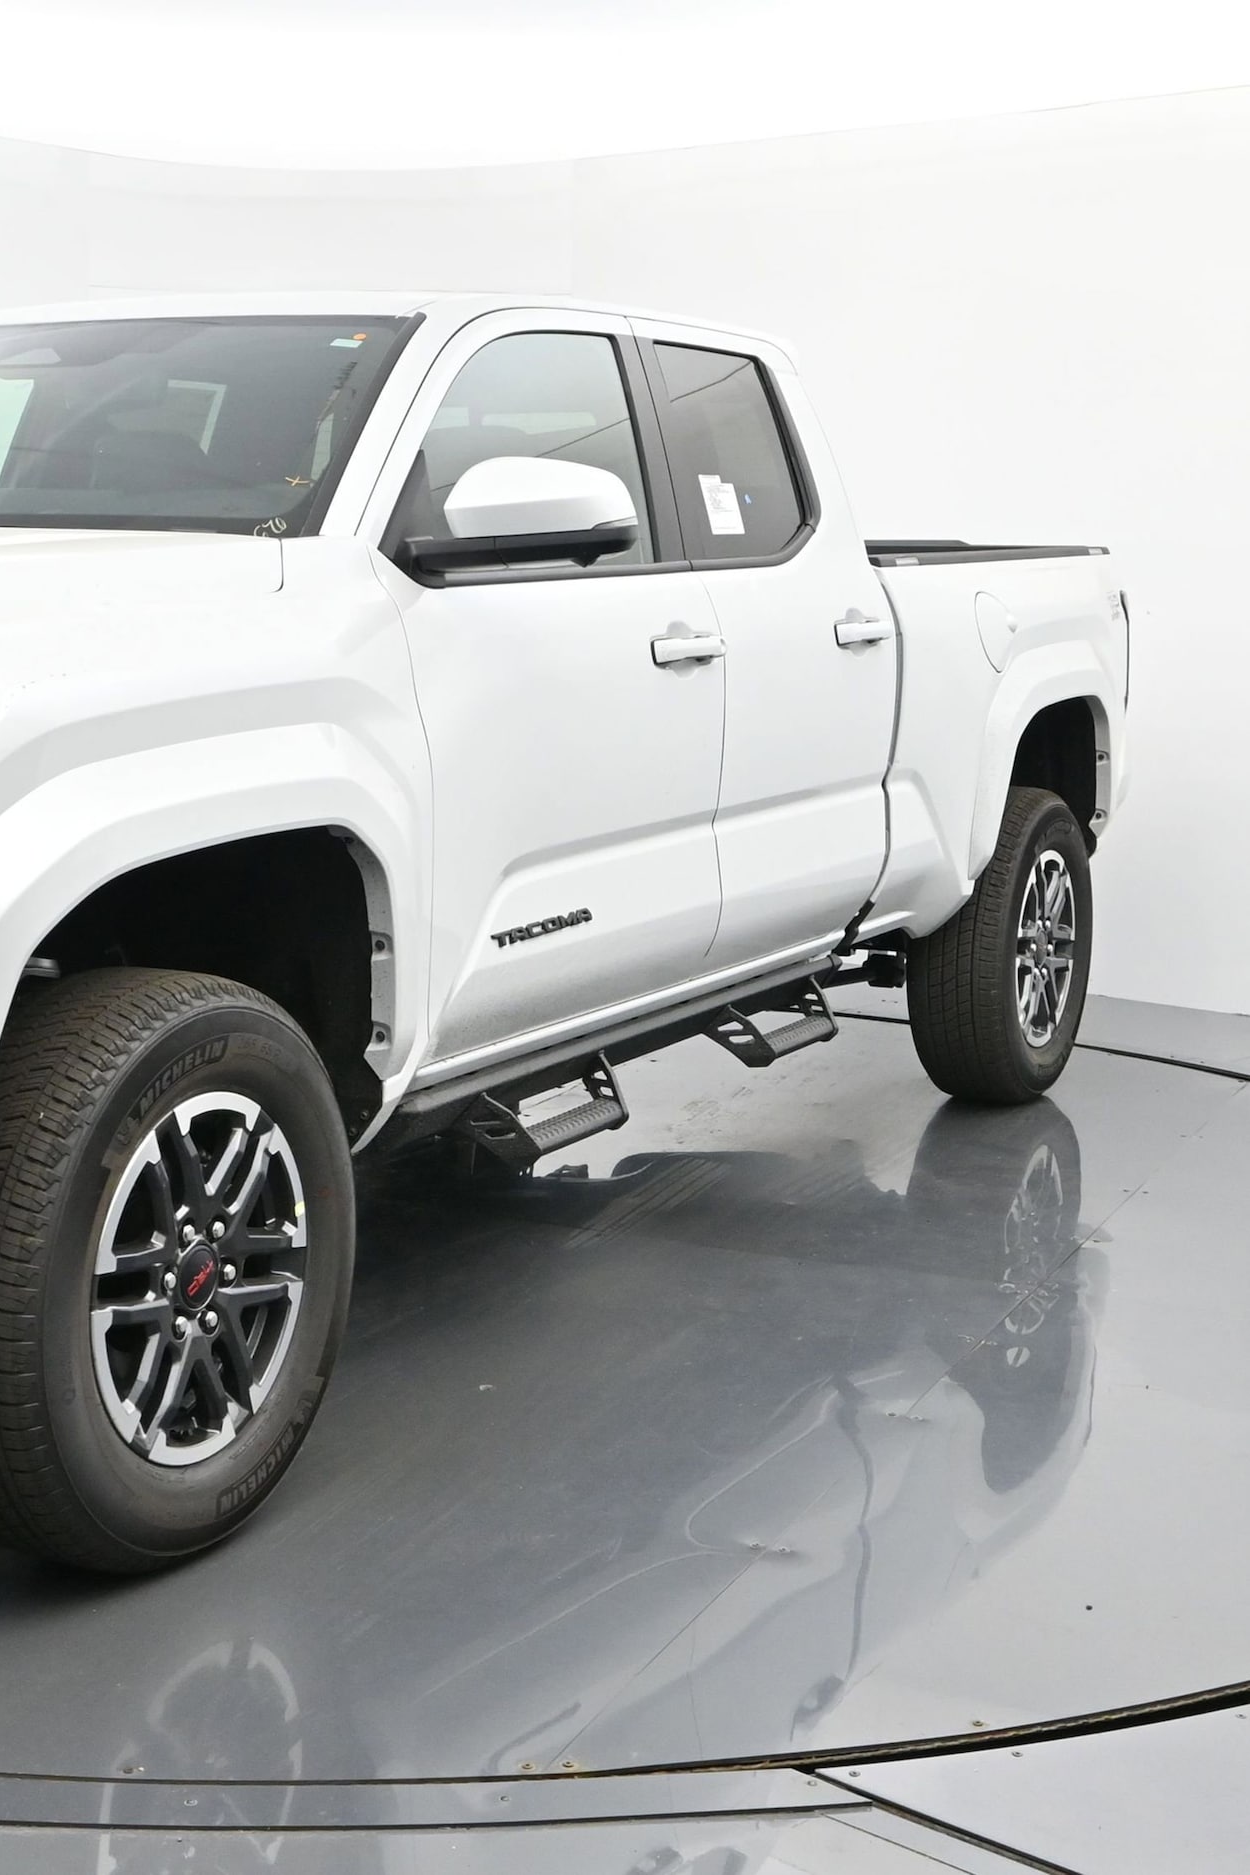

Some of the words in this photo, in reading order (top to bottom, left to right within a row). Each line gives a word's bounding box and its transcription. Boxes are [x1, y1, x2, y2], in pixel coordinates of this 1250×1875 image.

[491, 907, 593, 947] TACOMA
[140, 1040, 225, 1116] MICHELIN
[221, 1427, 295, 1513] MICHELIN
